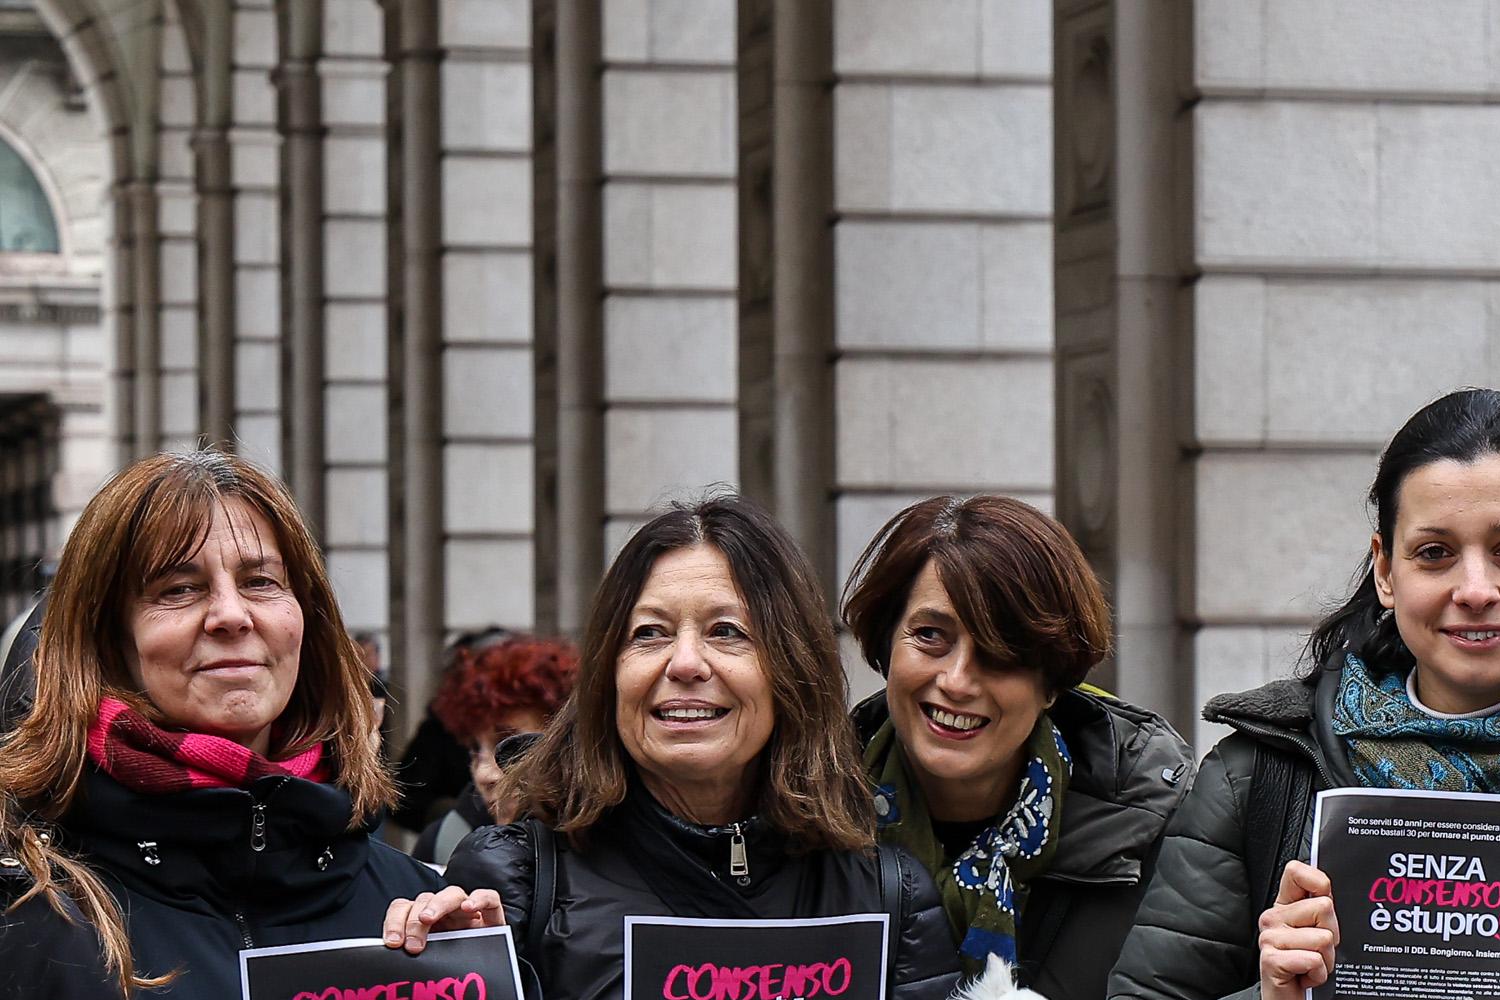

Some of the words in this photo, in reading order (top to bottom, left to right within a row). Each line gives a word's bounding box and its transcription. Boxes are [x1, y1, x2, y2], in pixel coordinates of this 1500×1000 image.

[1347, 815, 1368, 825] Sono
[1368, 817, 1391, 826] serviti
[1392, 817, 1403, 827] 50
[1404, 818, 1422, 828] anni
[1422, 820, 1436, 829] per
[1436, 821, 1461, 830] essere
[1347, 825, 1359, 835] Ne
[1360, 827, 1379, 836] sono
[1380, 827, 1405, 837] bastati
[1406, 828, 1416, 837] 30
[1416, 830, 1430, 839] per
[1431, 829, 1461, 840] tornare
[1461, 831, 1469, 840] al
[1469, 832, 1495, 842] punto
[1388, 853, 1486, 882] SENZA
[1370, 903, 1390, 931] è
[1363, 942, 1403, 954] Fermiamo
[1403, 944, 1409, 954] il
[1410, 945, 1428, 955] DDL
[1429, 946, 1474, 958] Bongiorno.
